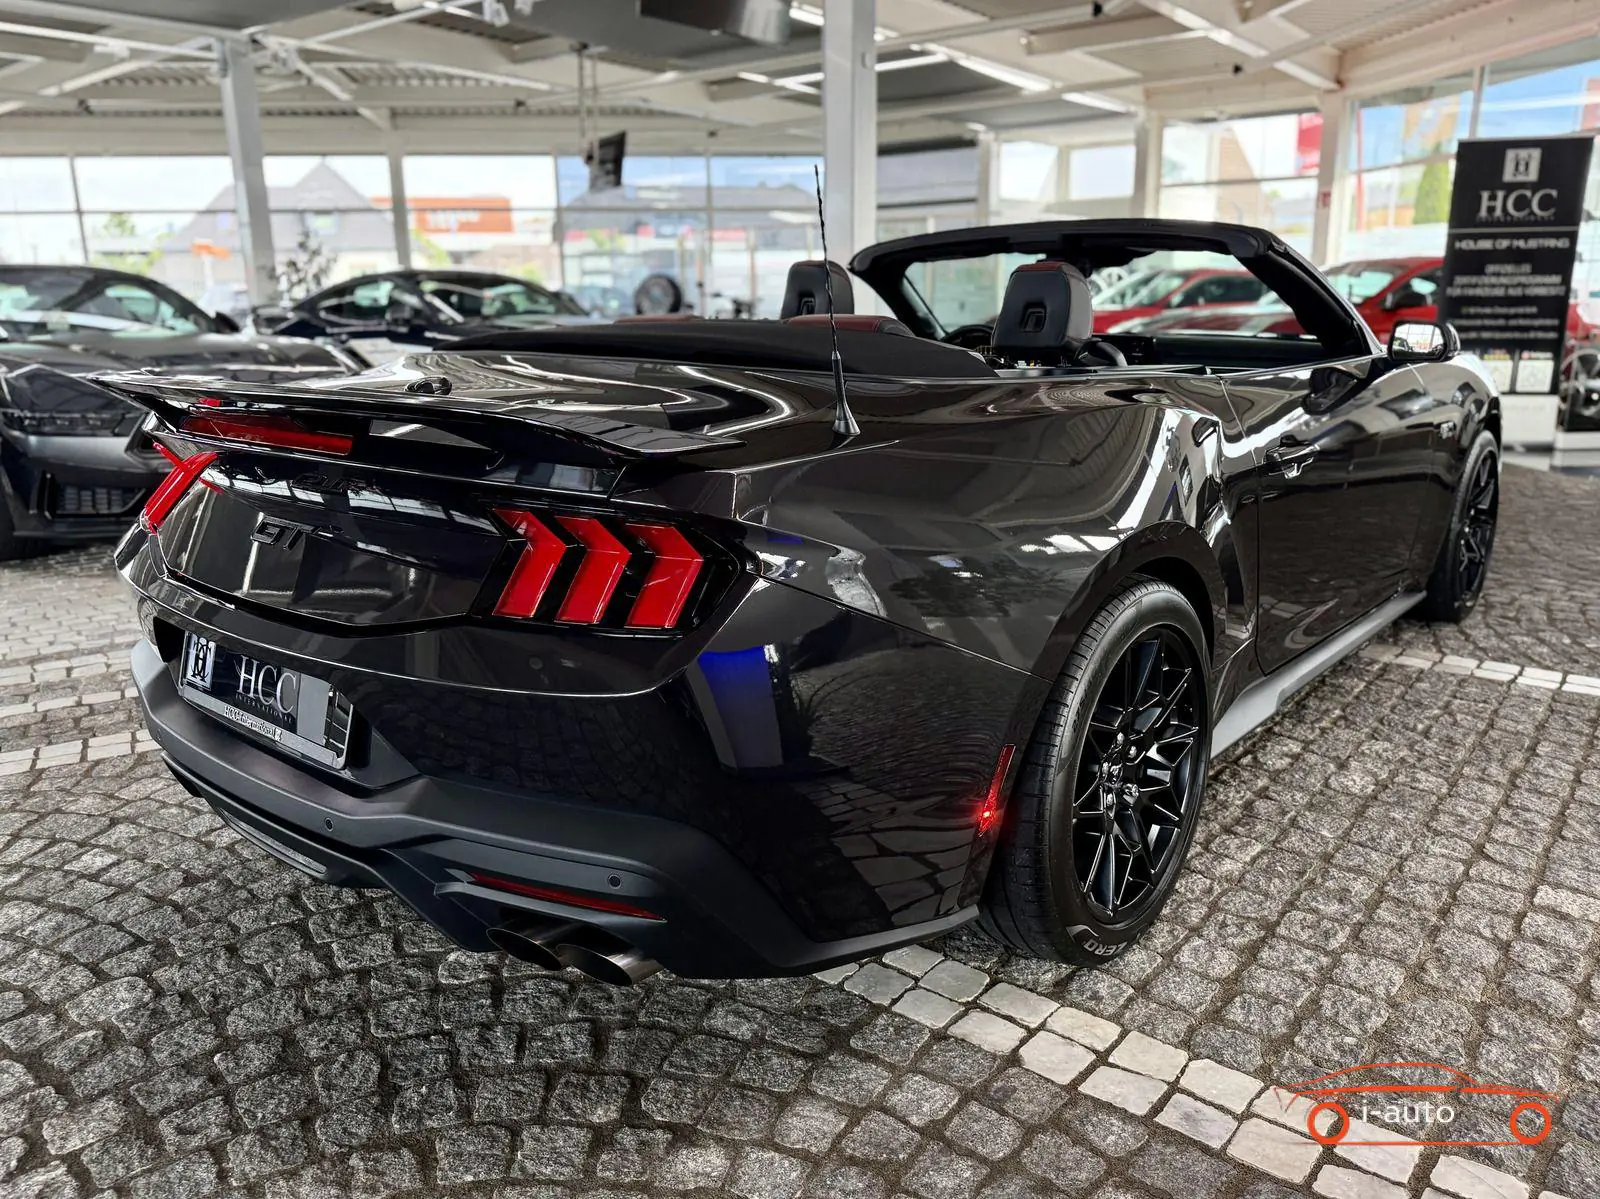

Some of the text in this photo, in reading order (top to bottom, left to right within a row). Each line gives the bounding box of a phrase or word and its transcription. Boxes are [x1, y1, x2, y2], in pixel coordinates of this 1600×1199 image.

[1478, 188, 1558, 218] HCC
[1454, 239, 1494, 250] HOUSE
[1495, 239, 1511, 250] OF
[250, 515, 319, 550] GT
[236, 654, 297, 714] HCC
